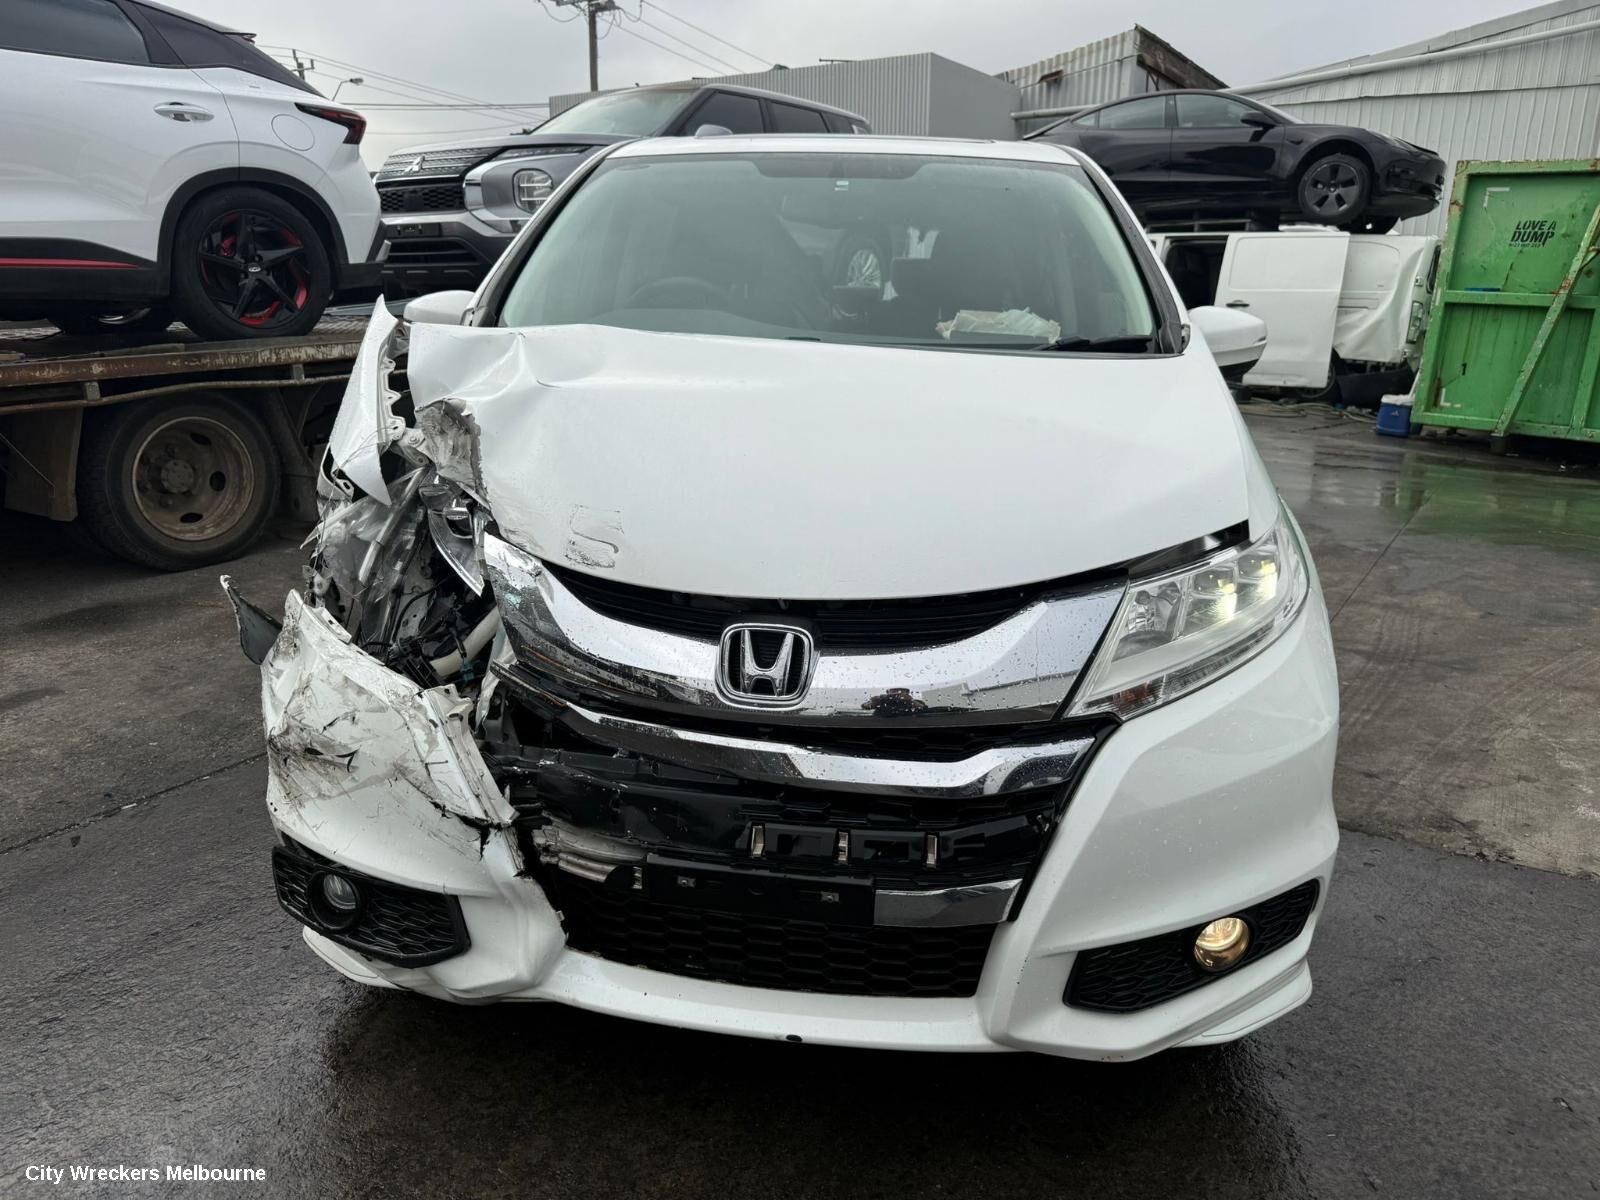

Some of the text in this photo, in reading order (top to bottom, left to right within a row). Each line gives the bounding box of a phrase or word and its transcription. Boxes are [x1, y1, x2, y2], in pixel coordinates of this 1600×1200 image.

[1515, 220, 1557, 231] LOVE A
[1510, 230, 1555, 247] DUMP
